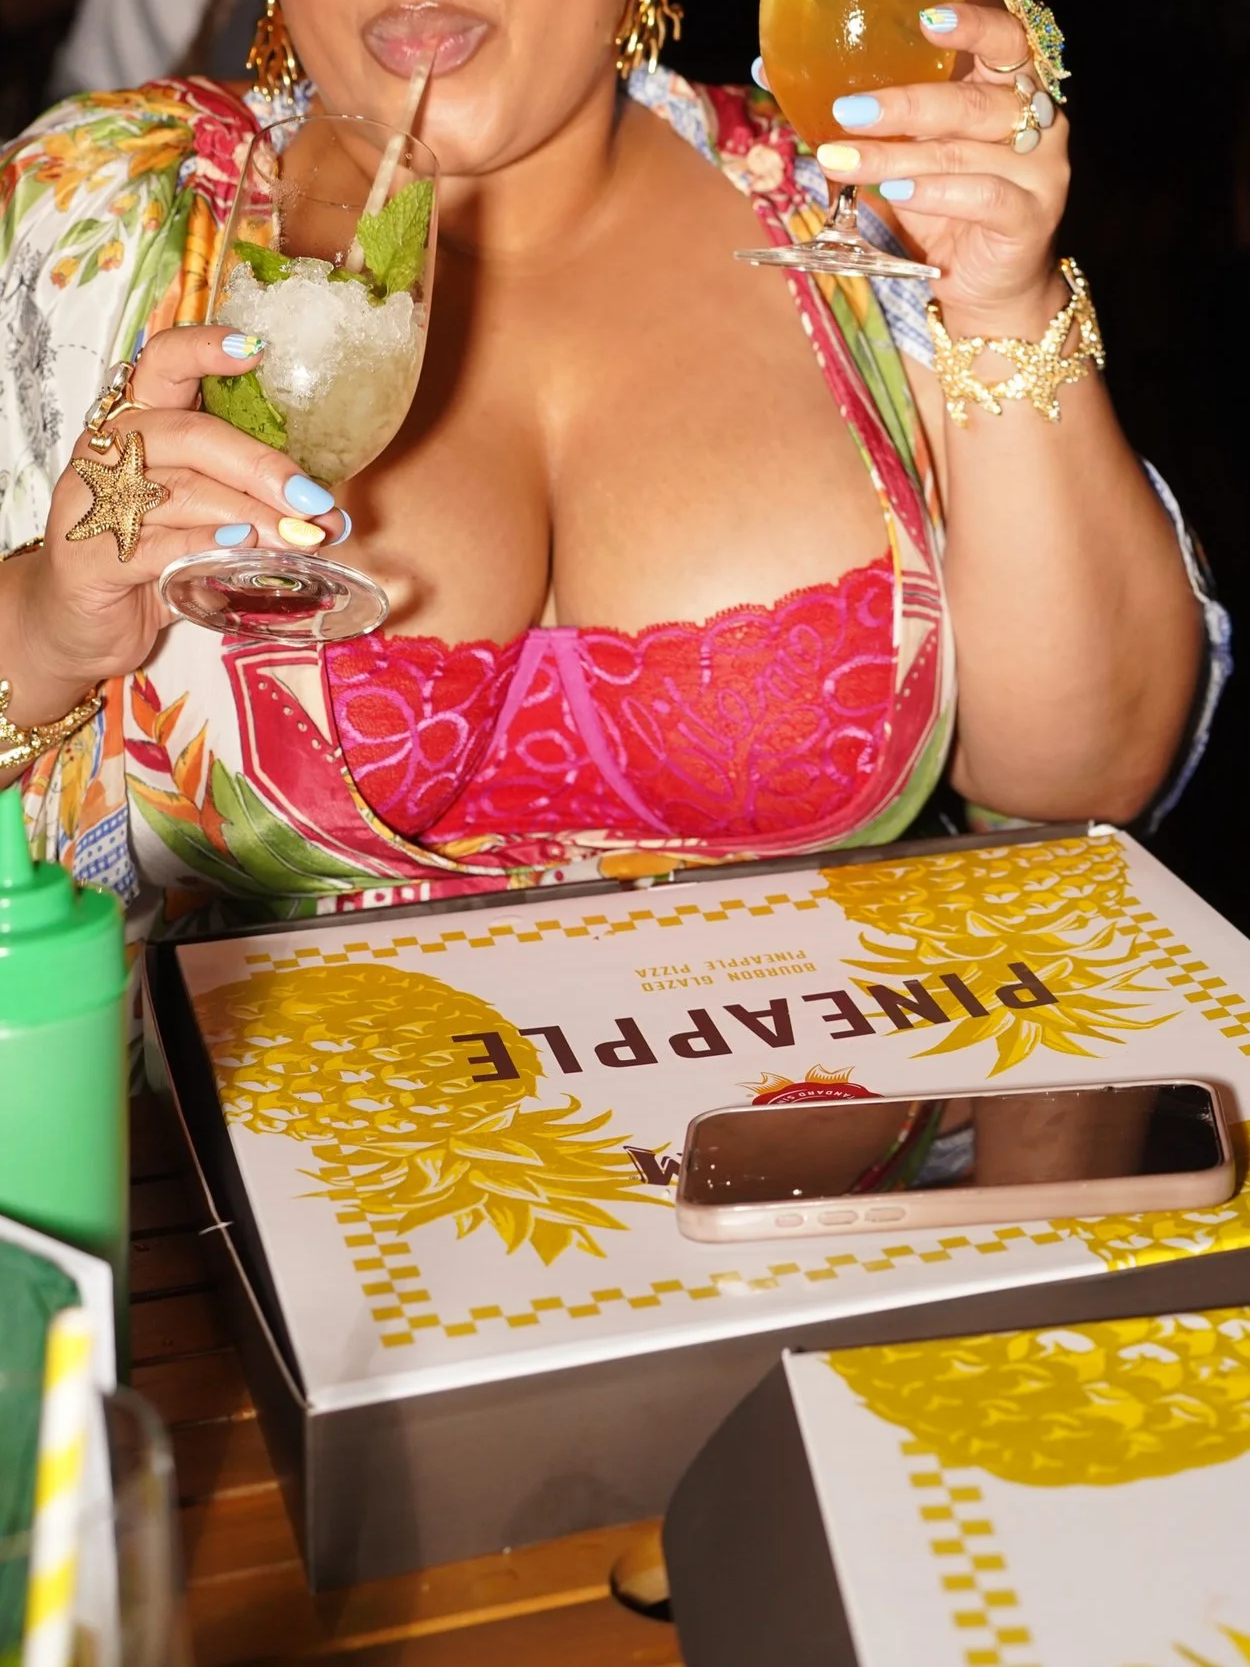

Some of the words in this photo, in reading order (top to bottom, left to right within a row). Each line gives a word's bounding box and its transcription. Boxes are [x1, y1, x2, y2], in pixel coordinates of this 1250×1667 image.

[705, 950, 807, 970] PINEAPPLE
[635, 964, 691, 979] PIZZA
[728, 962, 817, 982] BOURBON
[641, 975, 714, 992] GLAZED
[451, 961, 1059, 1083] PINEAPPLE
[798, 1090, 856, 1100] TANDARD
